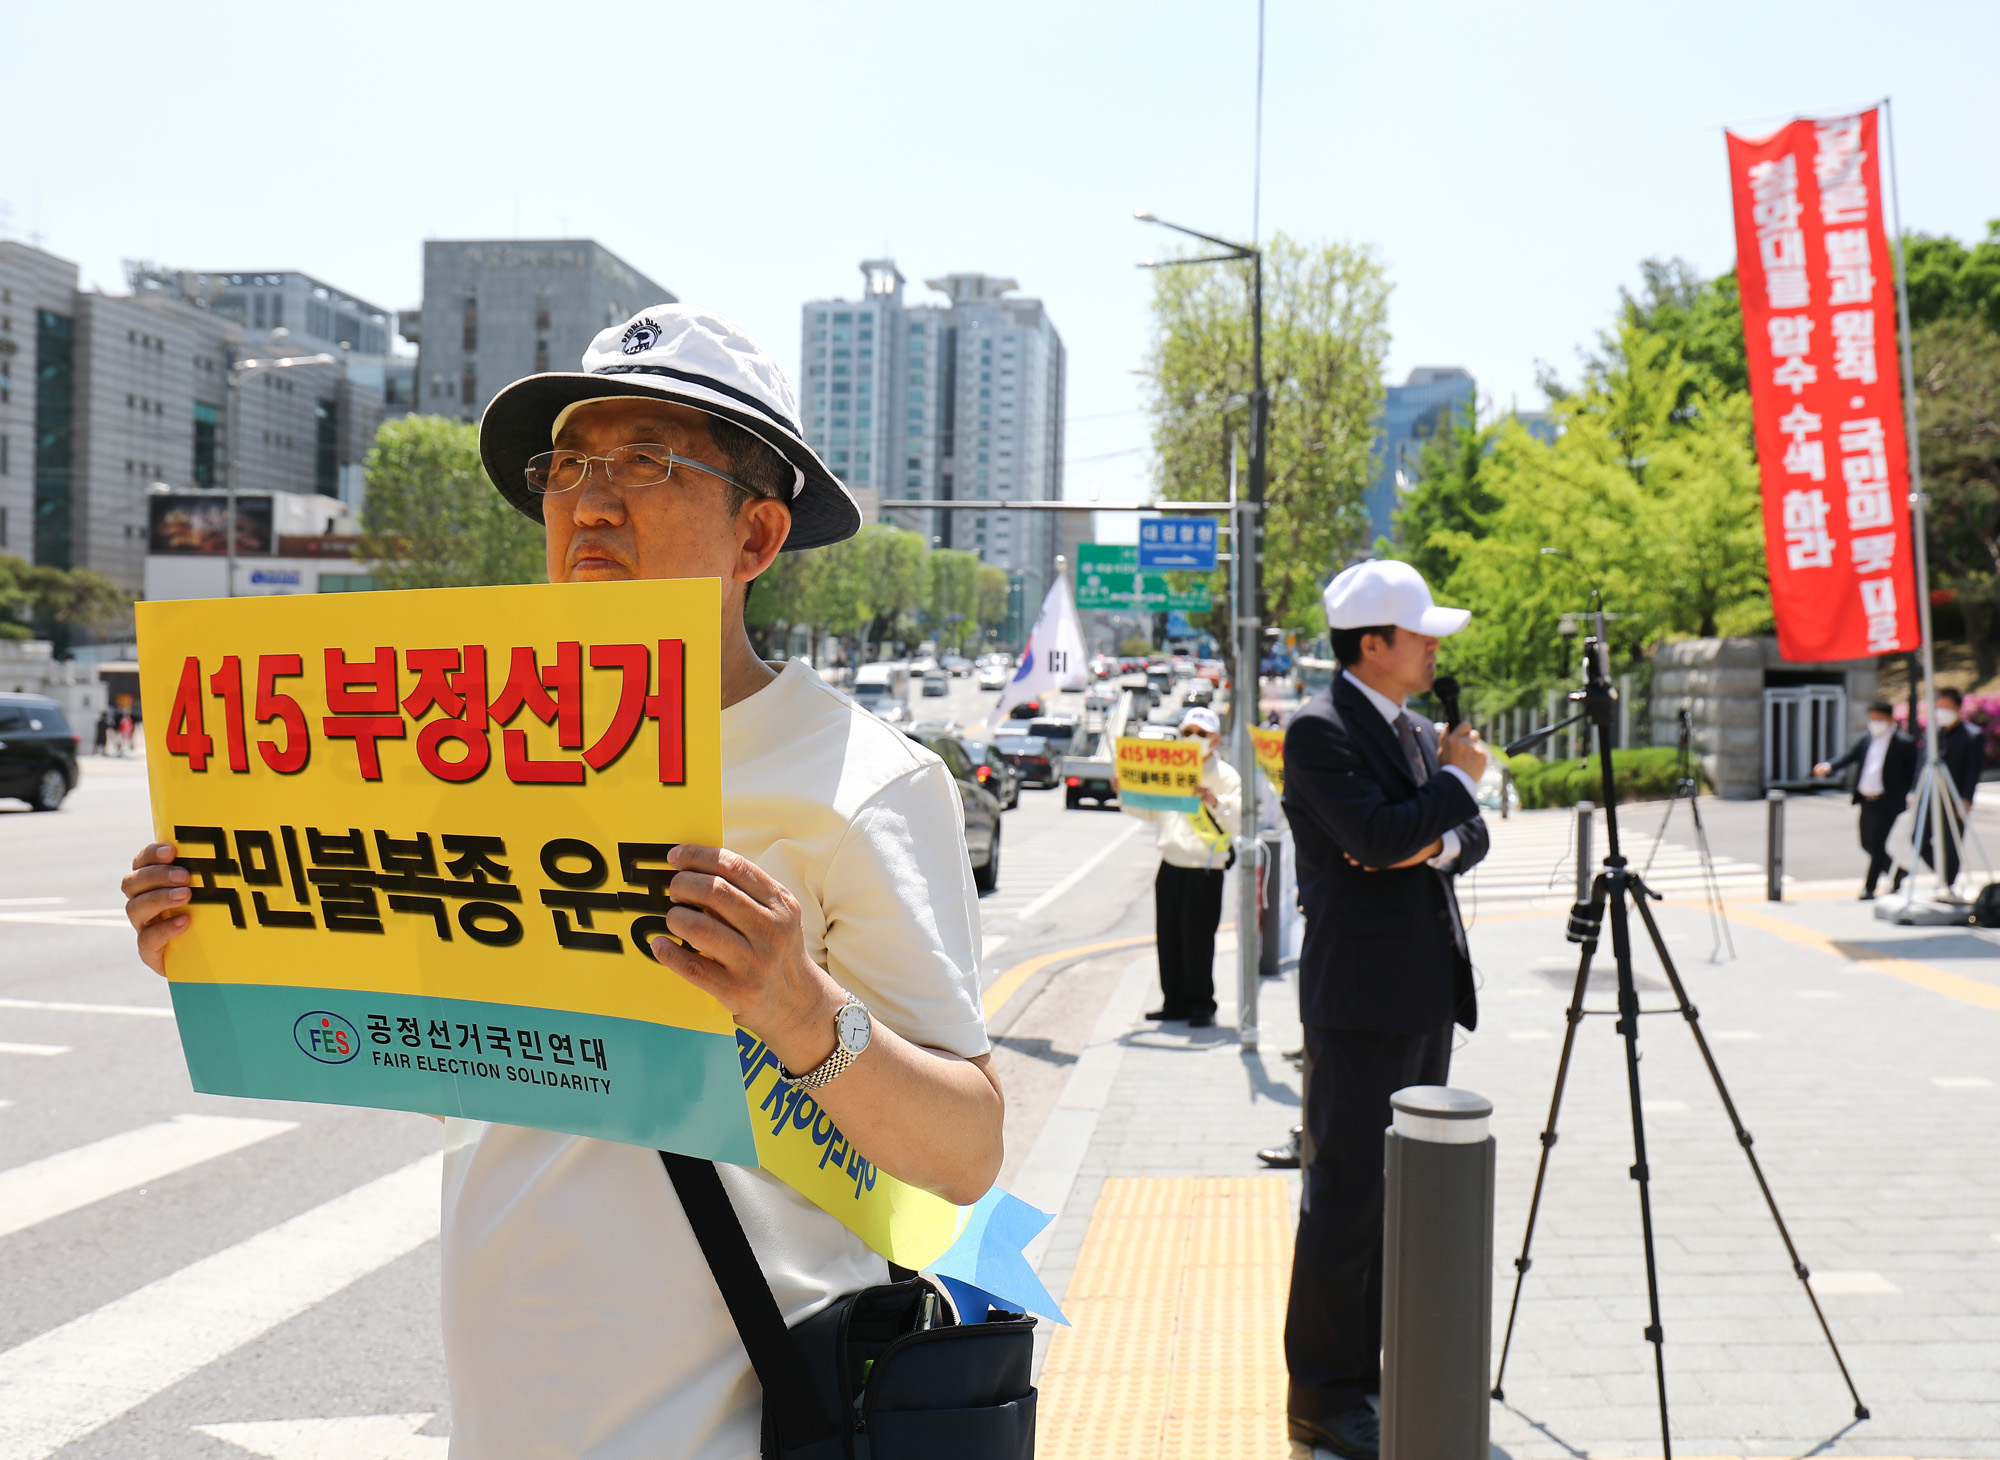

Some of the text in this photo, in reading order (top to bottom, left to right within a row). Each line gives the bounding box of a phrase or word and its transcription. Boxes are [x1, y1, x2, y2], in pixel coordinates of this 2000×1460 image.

[1767, 314, 1818, 395] 압수
[1779, 403, 1826, 482] 수색
[1783, 489, 1836, 570] 하라
[165, 638, 686, 785] 415 부정선거
[1120, 746, 1198, 767] 415 부정선거
[172, 825, 525, 947] 국민불복종
[309, 1028, 351, 1056] FES
[366, 1013, 609, 1072] 공정선거국민연대
[372, 1051, 613, 1096] FAIR ELECTION SOLIDARITY
